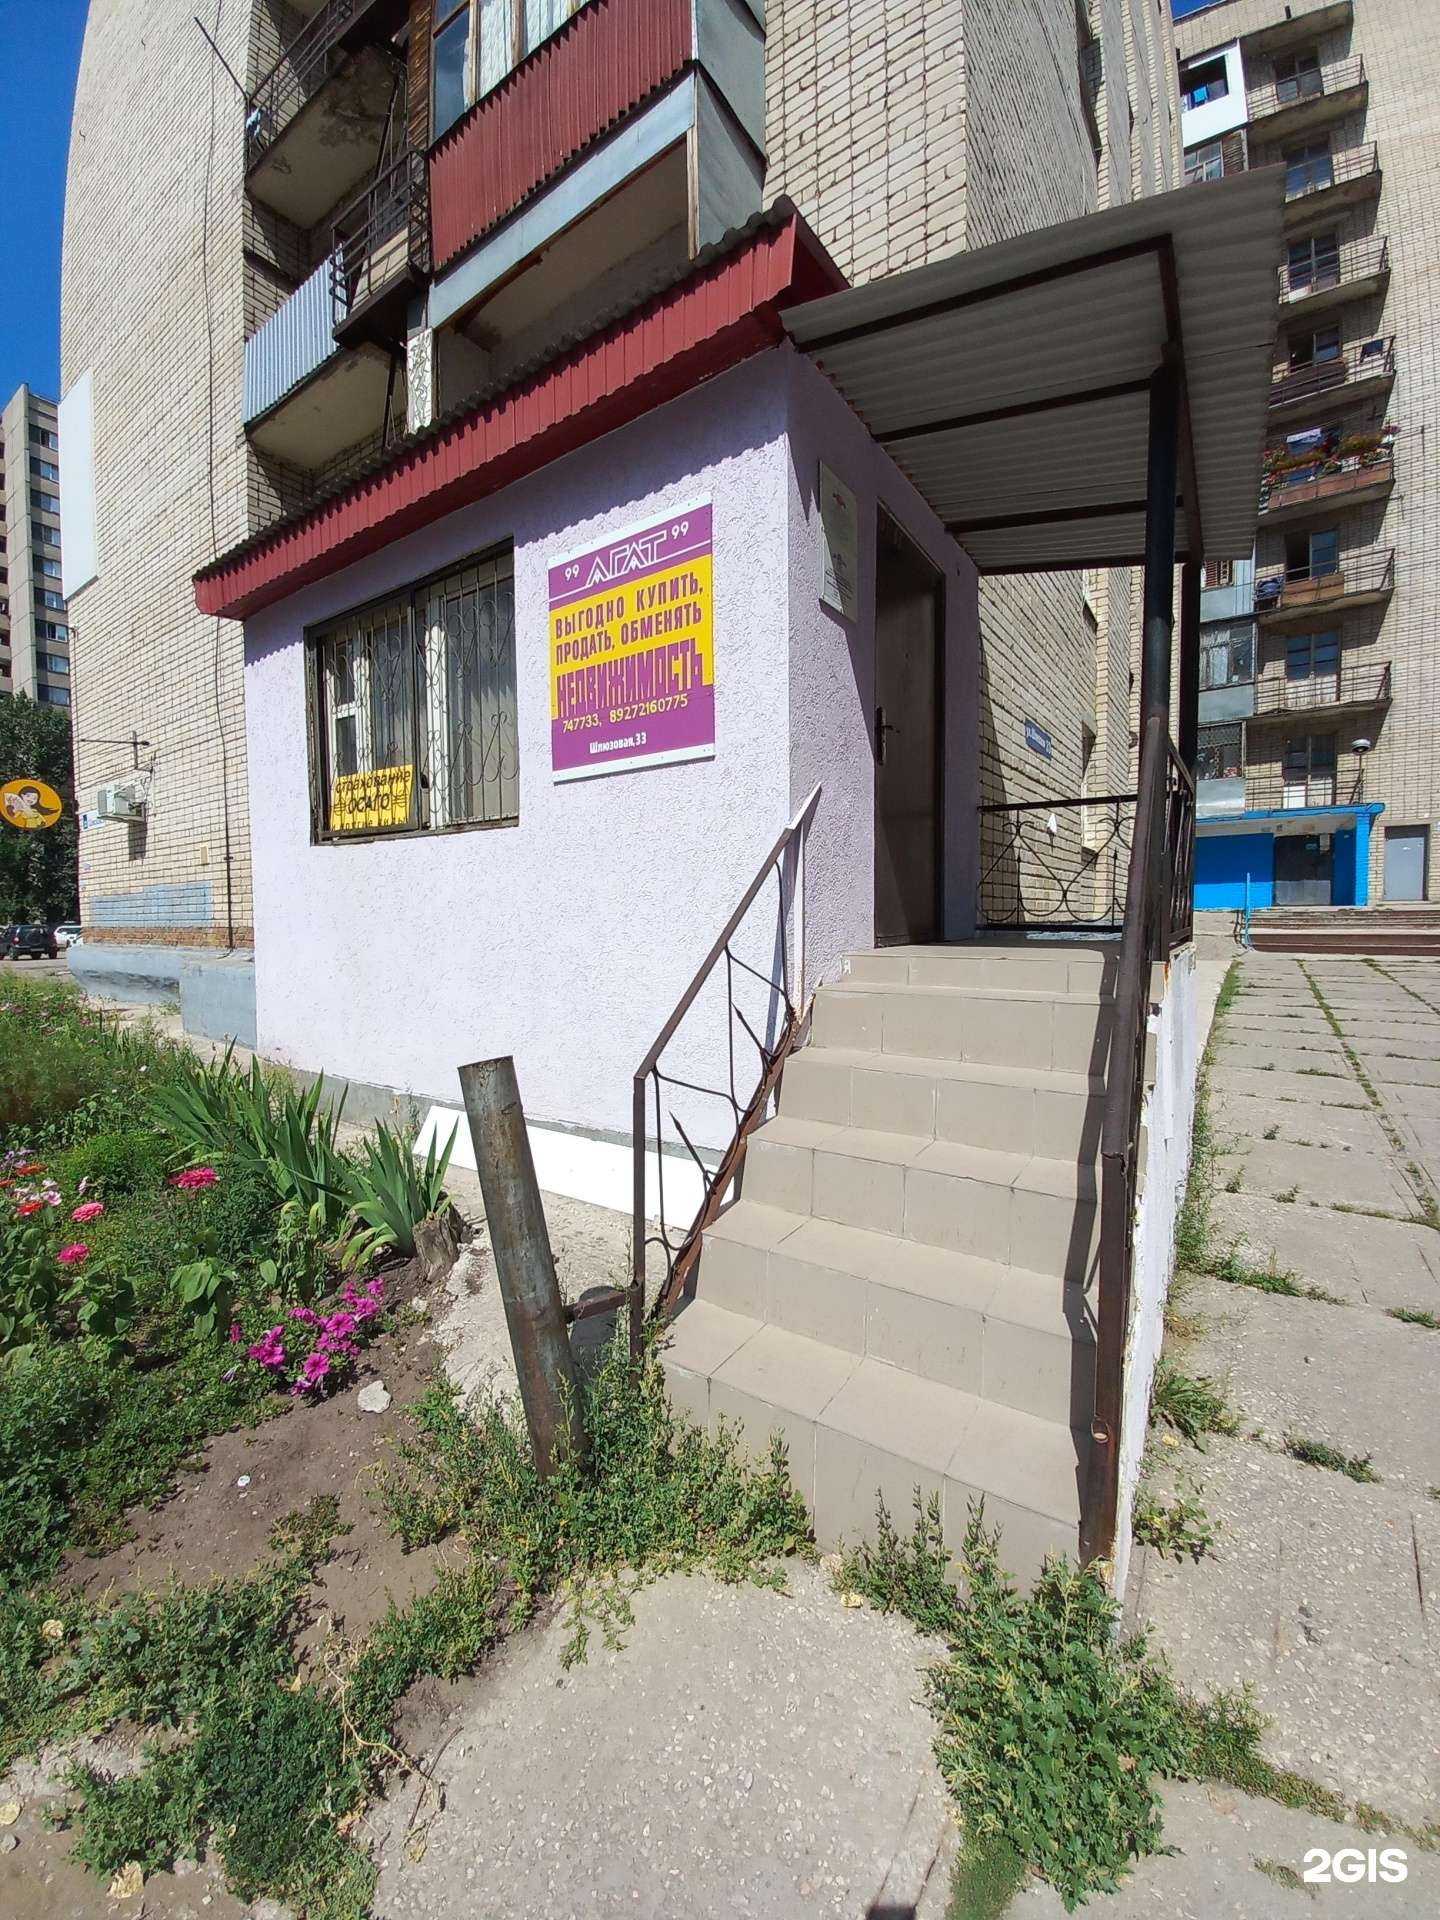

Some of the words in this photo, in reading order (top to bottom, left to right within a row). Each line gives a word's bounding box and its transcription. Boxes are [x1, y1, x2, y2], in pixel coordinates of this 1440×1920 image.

[564, 564, 580, 581] 99
[587, 530, 667, 586] АГАТ
[671, 521, 689, 540] 99
[555, 596, 625, 639] ВЫГОДНО
[636, 571, 703, 613] КУПИТЬ,
[555, 629, 615, 666] ПРОДАТЬ,
[620, 601, 702, 645] ОБМЕНЯТЬ
[556, 638, 703, 719] НЕДВИЖИМОСТЬ
[562, 713, 602, 733] 747733,
[609, 693, 688, 723] 89272160775
[347, 793, 390, 814] ОСАГО
